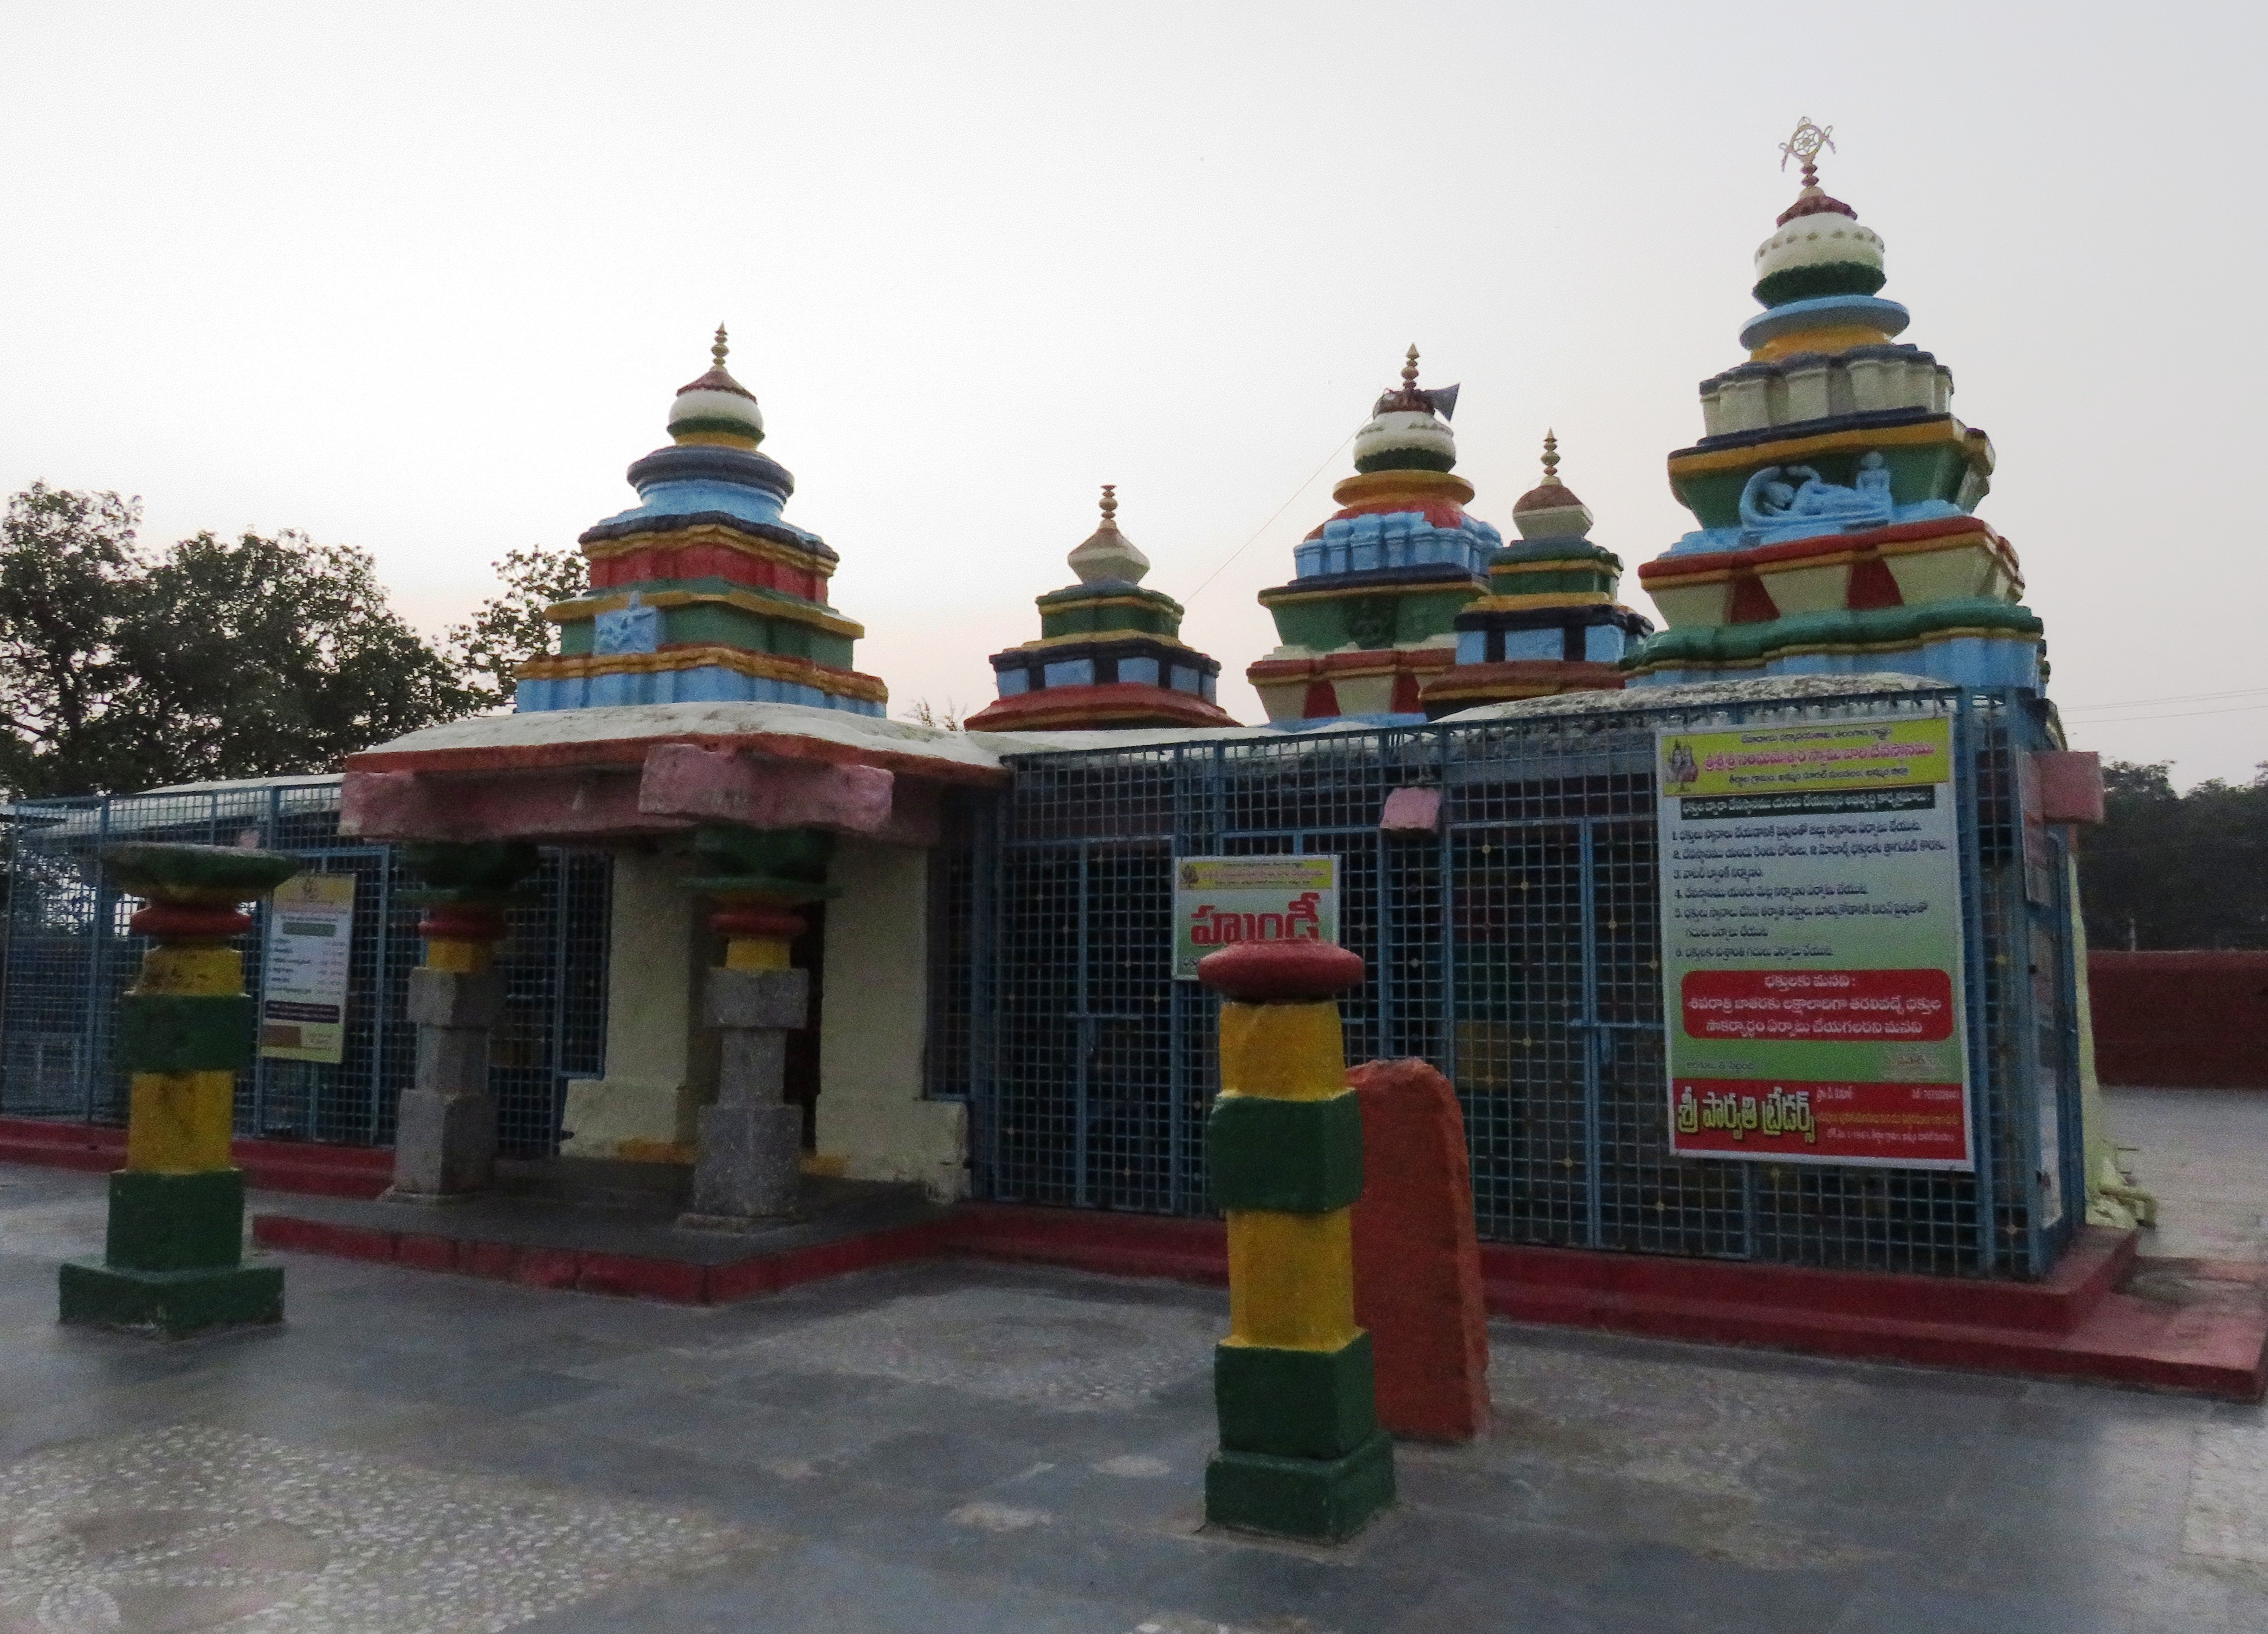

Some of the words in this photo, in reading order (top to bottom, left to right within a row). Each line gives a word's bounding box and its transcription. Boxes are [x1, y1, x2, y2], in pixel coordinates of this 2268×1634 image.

[1190, 892, 1321, 946] హుండీ
[1764, 974, 1811, 992] భక్తులకు
[1812, 974, 1850, 987] మనవి
[1678, 1085, 1699, 1133] శ్రీ
[1702, 1091, 1758, 1140] పార్వతి
[1762, 1086, 1817, 1144] ట్రేడర్స్
